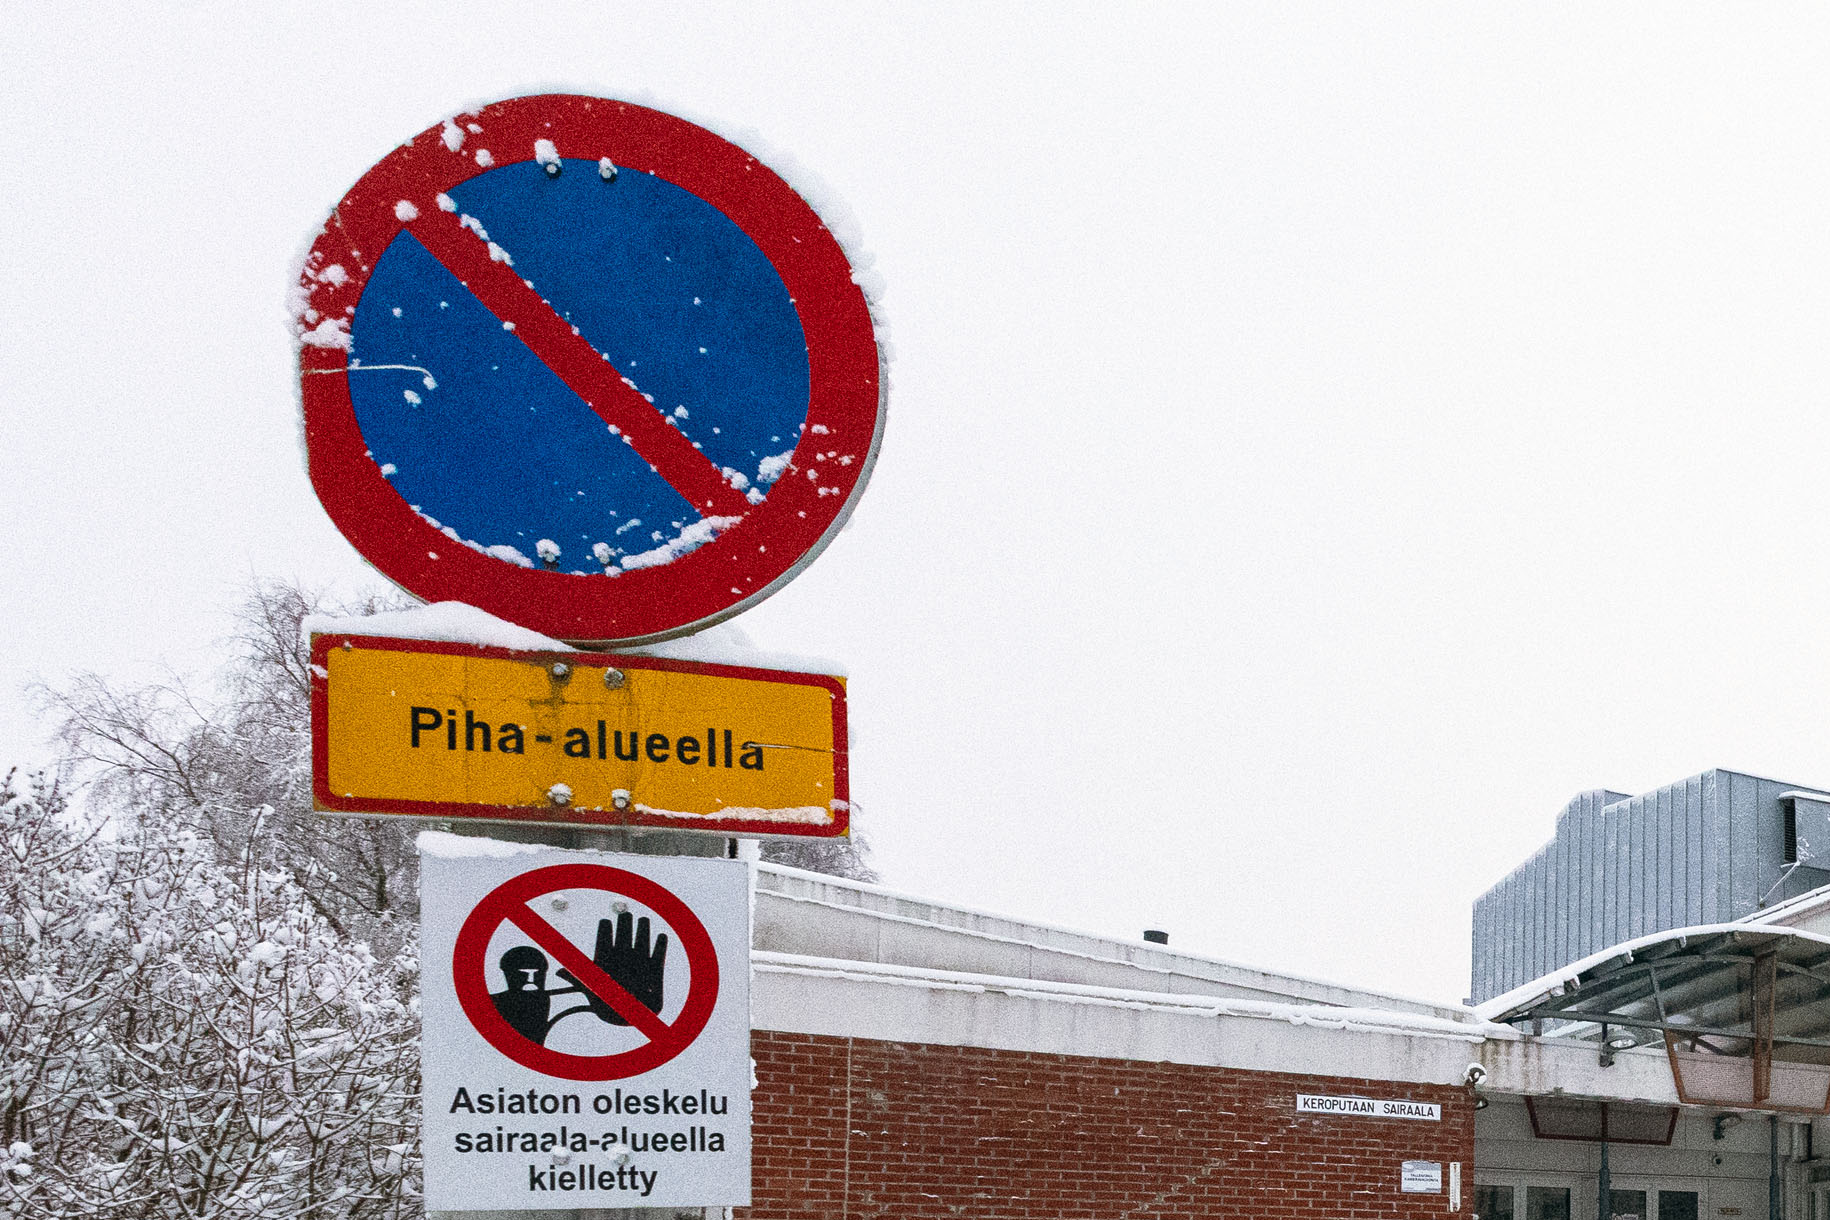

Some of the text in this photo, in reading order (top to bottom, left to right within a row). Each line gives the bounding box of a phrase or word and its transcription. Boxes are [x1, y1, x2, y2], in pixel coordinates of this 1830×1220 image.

[409, 705, 766, 771] Piha-alueella
[449, 1086, 728, 1115] Asiaton oleskelu
[1303, 1097, 1435, 1117] KEROPUTAAN SAIRAALA
[454, 1125, 726, 1153] sairaala-alueella
[528, 1163, 658, 1197] kielletty
